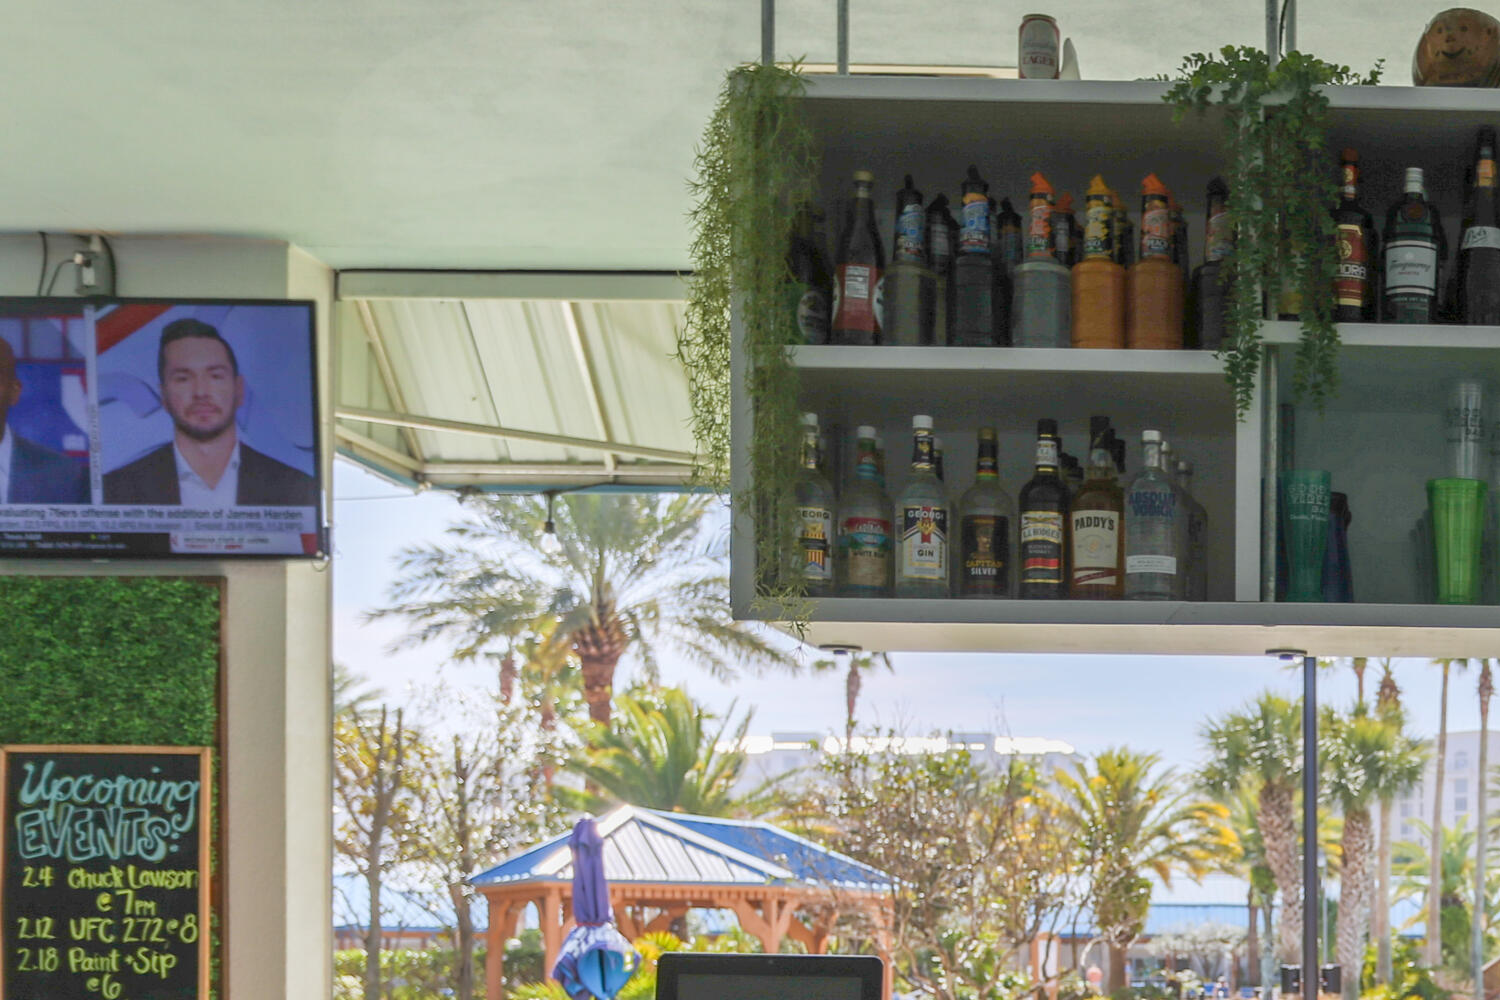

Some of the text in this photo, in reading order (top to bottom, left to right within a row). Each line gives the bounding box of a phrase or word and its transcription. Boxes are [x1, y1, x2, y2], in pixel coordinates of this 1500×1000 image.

[1074, 516, 1115, 531] PADDY'S
[917, 549, 935, 557] GIN
[19, 760, 200, 834] Upcoming
[67, 865, 124, 889] Chuck
[128, 864, 199, 889] Lawson
[70, 917, 115, 943] UFC
[122, 918, 166, 943] 272
[17, 948, 59, 972] 2.18
[68, 947, 121, 973] Paint
[132, 946, 177, 979] Sip
